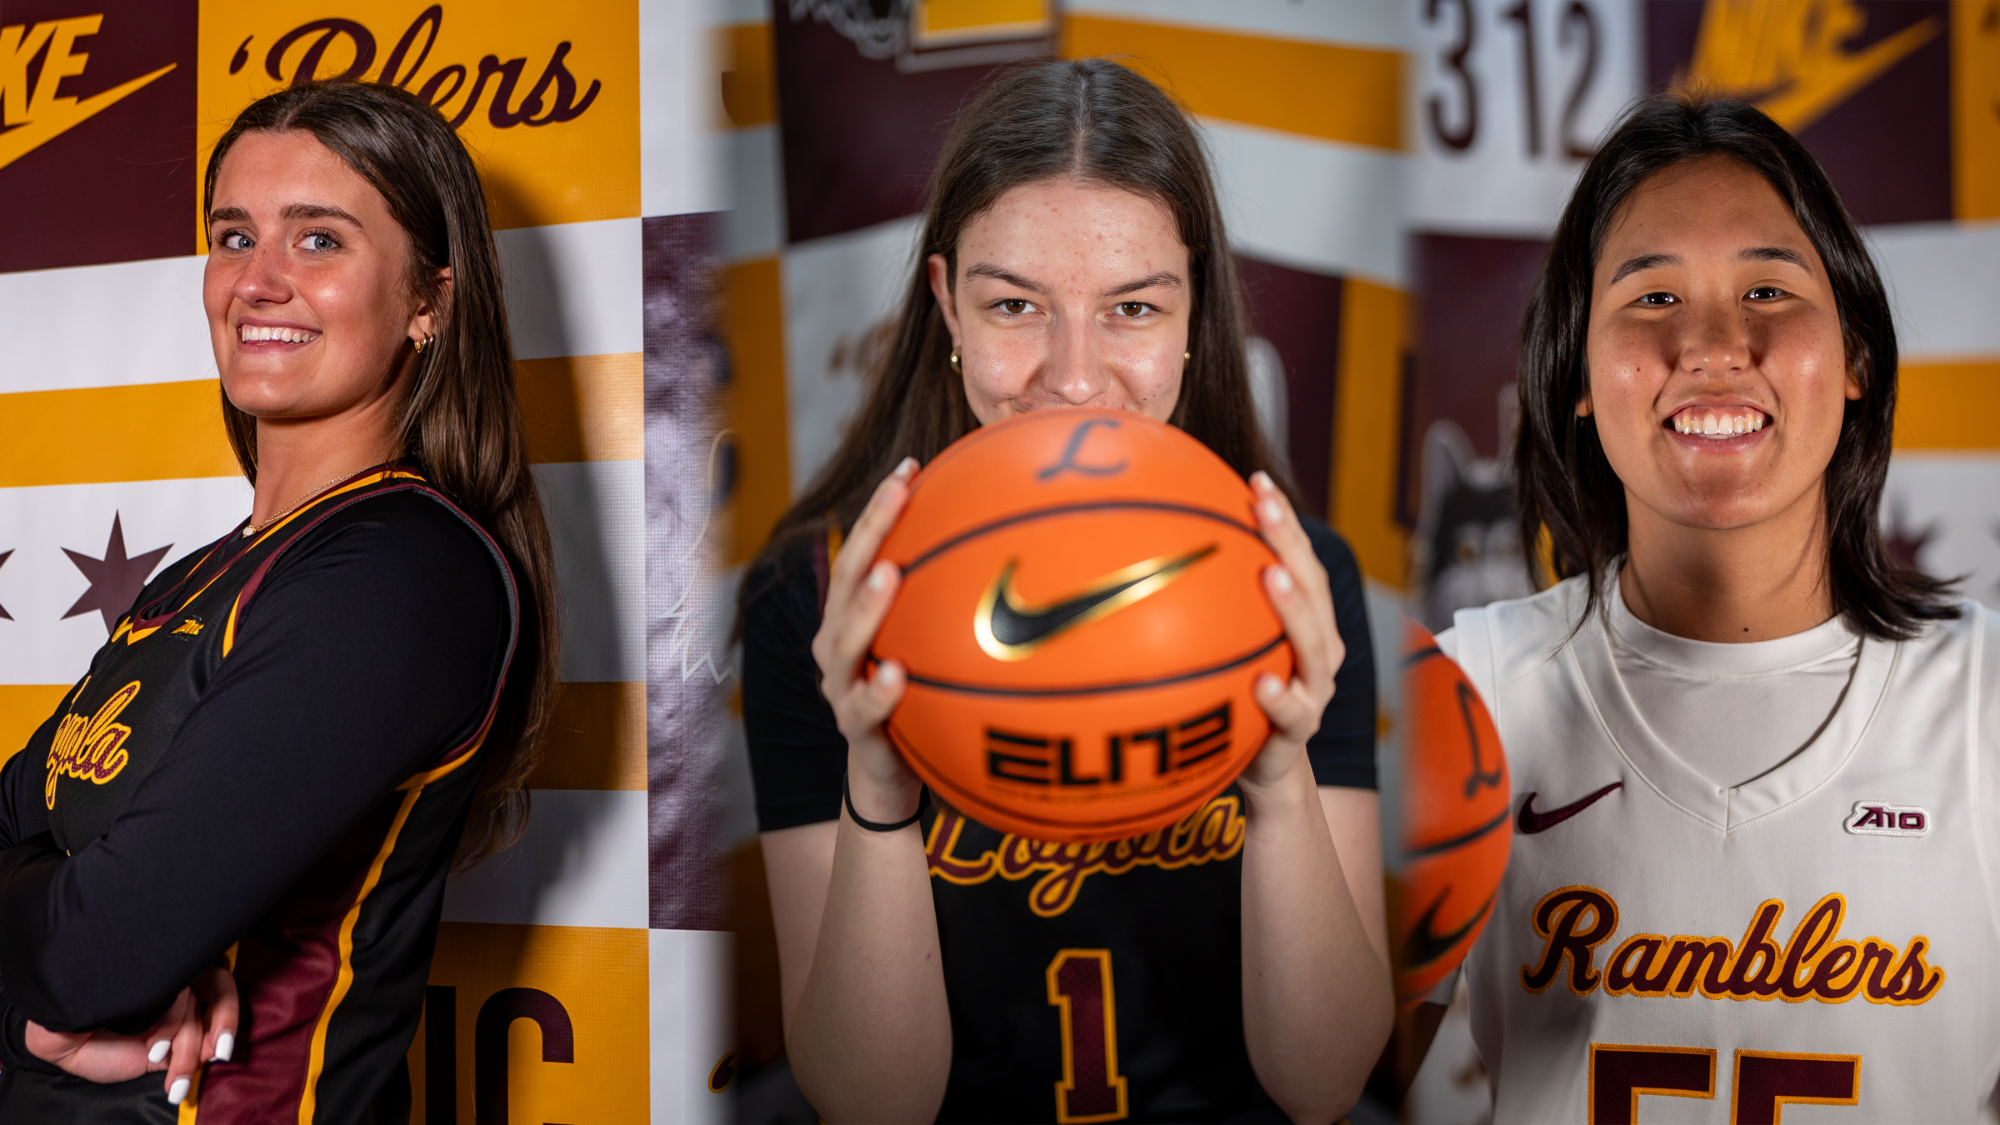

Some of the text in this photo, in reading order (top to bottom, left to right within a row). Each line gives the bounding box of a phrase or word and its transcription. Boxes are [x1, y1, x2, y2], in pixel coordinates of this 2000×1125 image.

[984, 700, 1233, 787] ELITE
[1851, 806, 1926, 830] A10
[1519, 885, 1945, 1006] Ramblers
[1045, 949, 1129, 1124] 1
